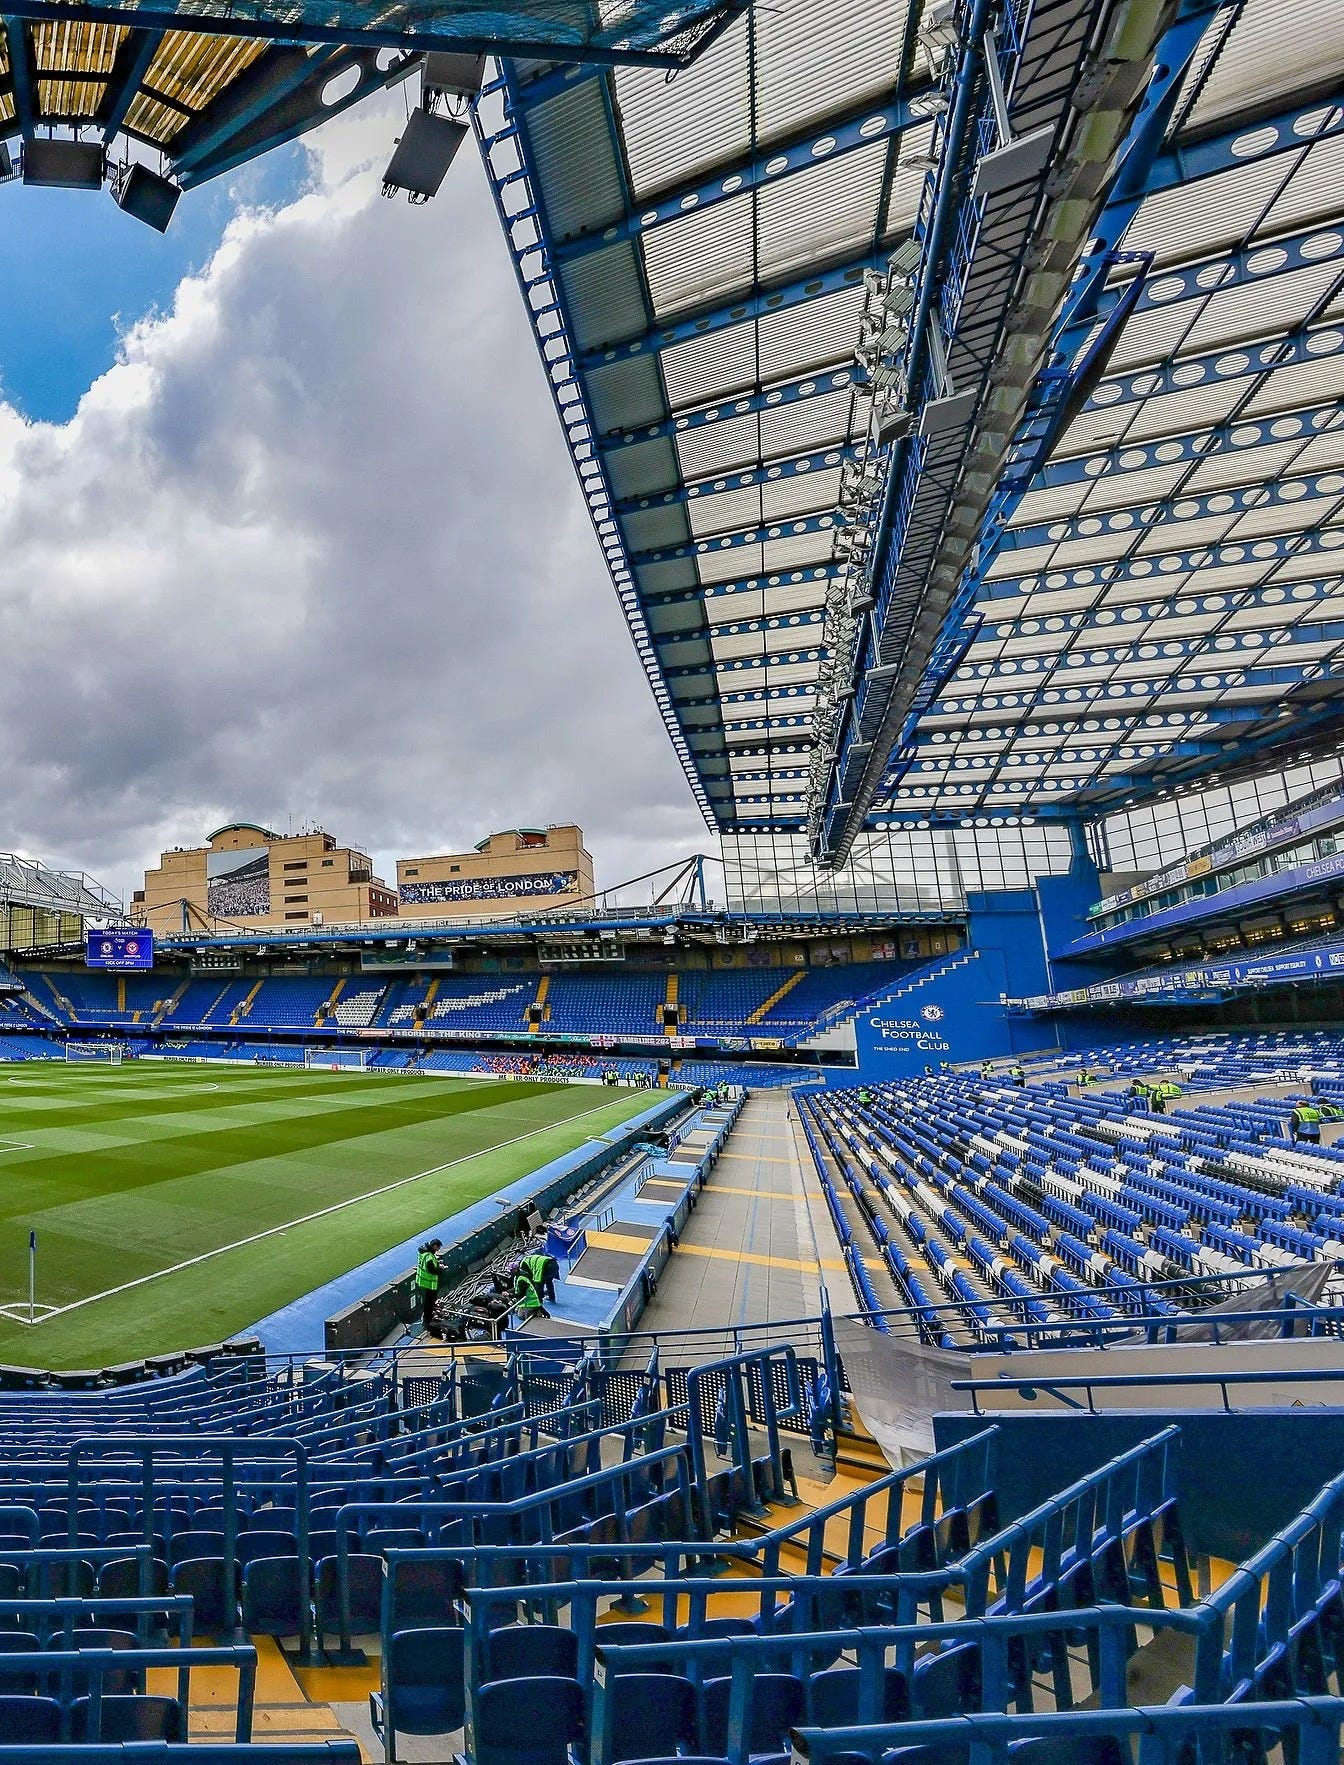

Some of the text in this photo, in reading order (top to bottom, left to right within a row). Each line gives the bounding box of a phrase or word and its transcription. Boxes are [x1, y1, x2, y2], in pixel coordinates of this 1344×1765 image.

[1306, 862, 1334, 879] CHELSEA
[420, 879, 553, 897] THE PRIDE OF LONDON
[1260, 965, 1274, 973] CHELSEA
[1289, 960, 1306, 969] EQUALITY
[870, 1017, 920, 1028] CHELSEA
[881, 1028, 942, 1040] FOOTBALL
[917, 1039, 950, 1050] CLUB
[540, 1076, 570, 1084] PRODUCTS
